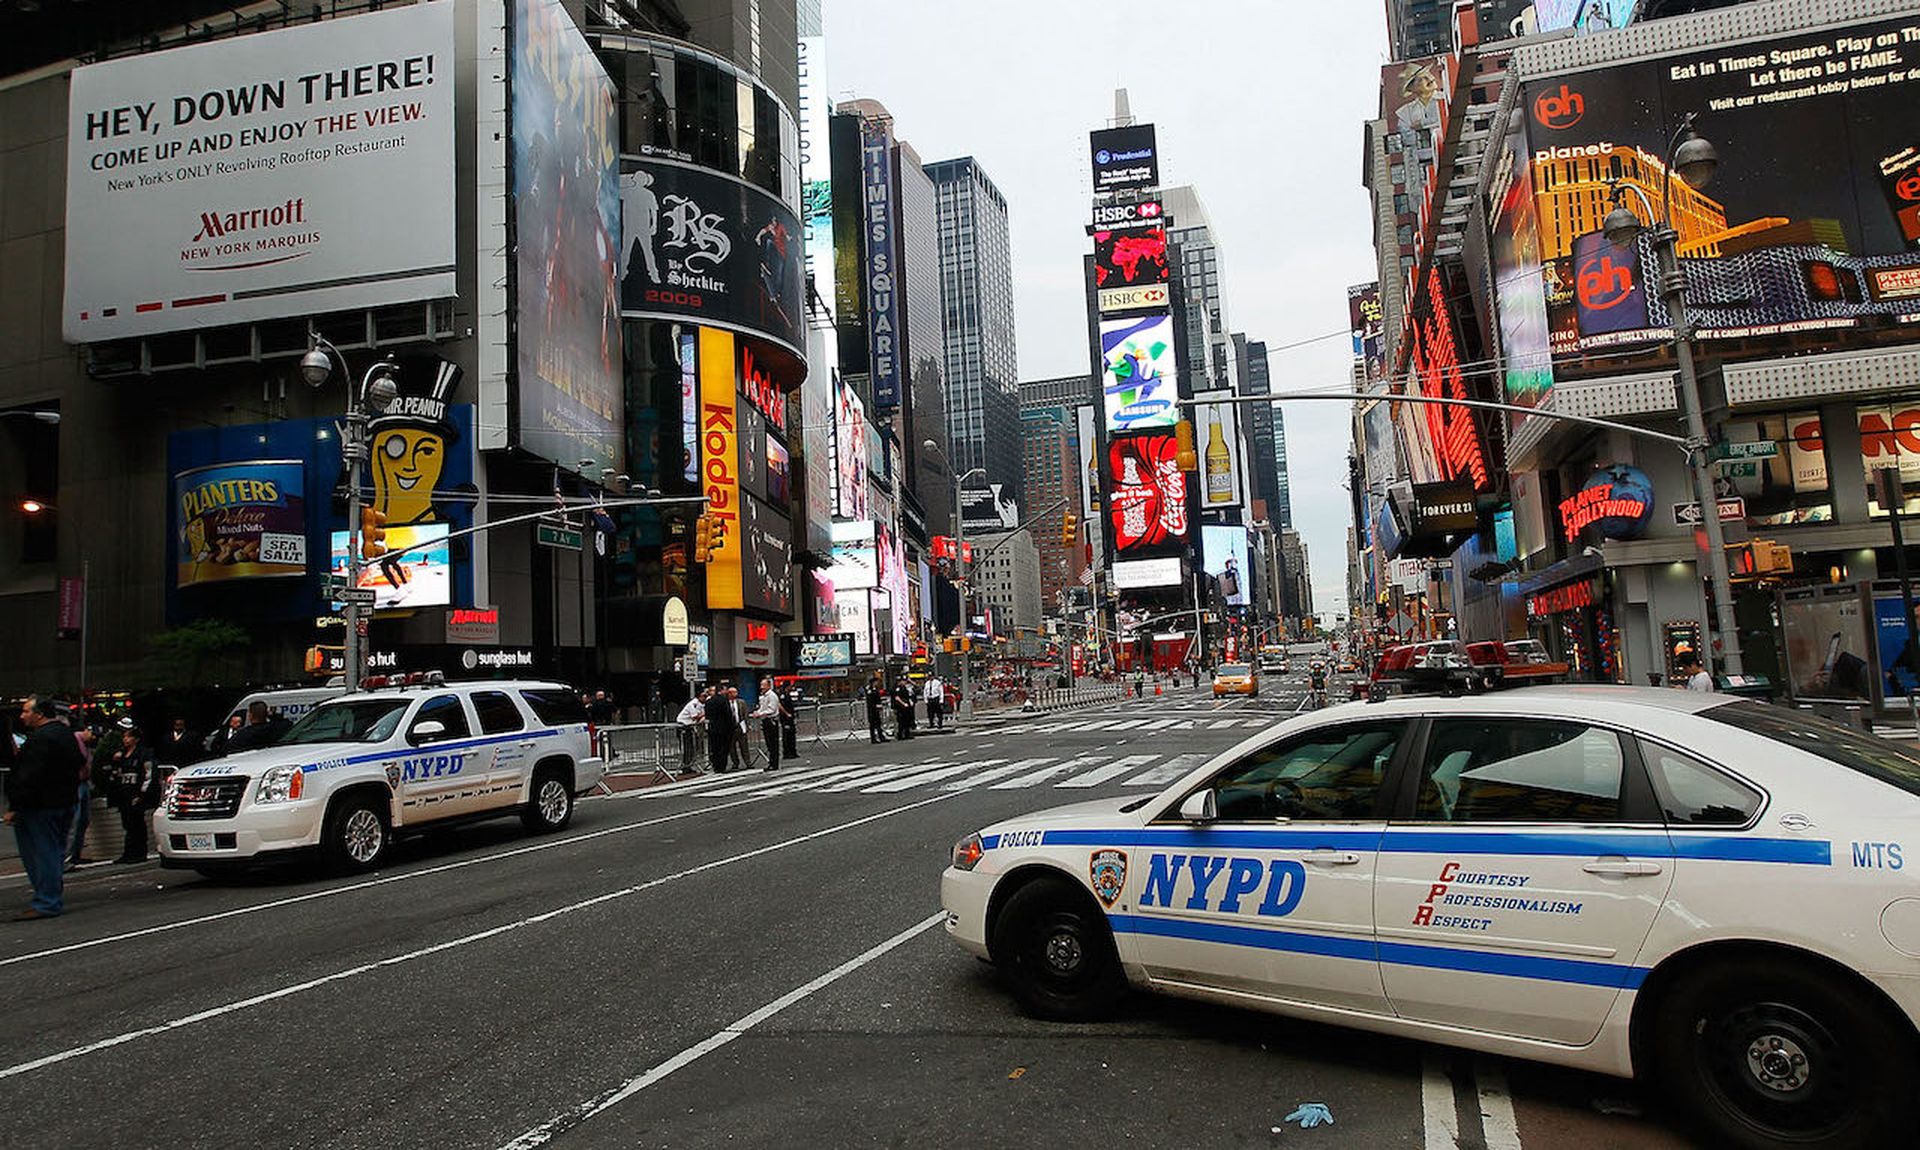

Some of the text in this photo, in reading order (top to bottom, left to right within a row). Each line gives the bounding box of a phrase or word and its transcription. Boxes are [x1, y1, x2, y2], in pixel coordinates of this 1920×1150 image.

[1670, 62, 1699, 81] Eat
[1700, 59, 1716, 77] in
[1718, 53, 1767, 74] Times
[1769, 40, 1834, 67] Square.
[1836, 34, 1875, 59] Play
[1876, 31, 1899, 47] on
[1750, 49, 1903, 88] Let there be FAME.
[86, 54, 435, 141] HEY, DOWN THERE!
[1709, 97, 1735, 111] Visit
[1736, 95, 1755, 108] our
[1757, 85, 1816, 104] restaurant
[1817, 79, 1849, 99] lobby
[1851, 72, 1887, 93] below
[1888, 70, 1906, 86] for
[1534, 85, 1585, 129] ph
[91, 102, 426, 171] COME UP AND ENJOY THE VIEW.
[107, 135, 406, 193] New York's ONLY Revolving Rooftop Restaurant
[1535, 141, 1614, 166] planet
[193, 198, 307, 242] Marriott
[1094, 205, 1136, 224] HSBC
[181, 231, 321, 262] NEW YORK MARQUIS
[662, 194, 731, 274] RS
[866, 146, 893, 377] TIMES SQUARE
[1102, 290, 1142, 307] HSBC
[1550, 329, 1575, 343] SINO
[1580, 333, 1618, 349] PLANET
[404, 397, 446, 420] PEANUT
[183, 479, 279, 522] PLANTERS
[1422, 501, 1473, 517] FOREVER 21
[1558, 484, 1613, 526] PLANET
[243, 523, 265, 533] Nuts
[1565, 499, 1645, 543] HOLLYWOOD
[264, 550, 303, 562] SALT
[270, 540, 298, 551] SEA
[377, 651, 397, 667] hut
[478, 650, 532, 668] sunglass hut
[281, 704, 315, 716] POL
[317, 758, 347, 770] POLICE
[401, 754, 465, 781] NYPD
[1000, 830, 1043, 849] POLICE
[1851, 841, 1904, 870] MTS
[1139, 853, 1307, 918] NYPD
[1439, 862, 1530, 889] COURTESY
[1424, 883, 1584, 916] PROFESSIONALISM
[1412, 904, 1493, 932] RESPECT
